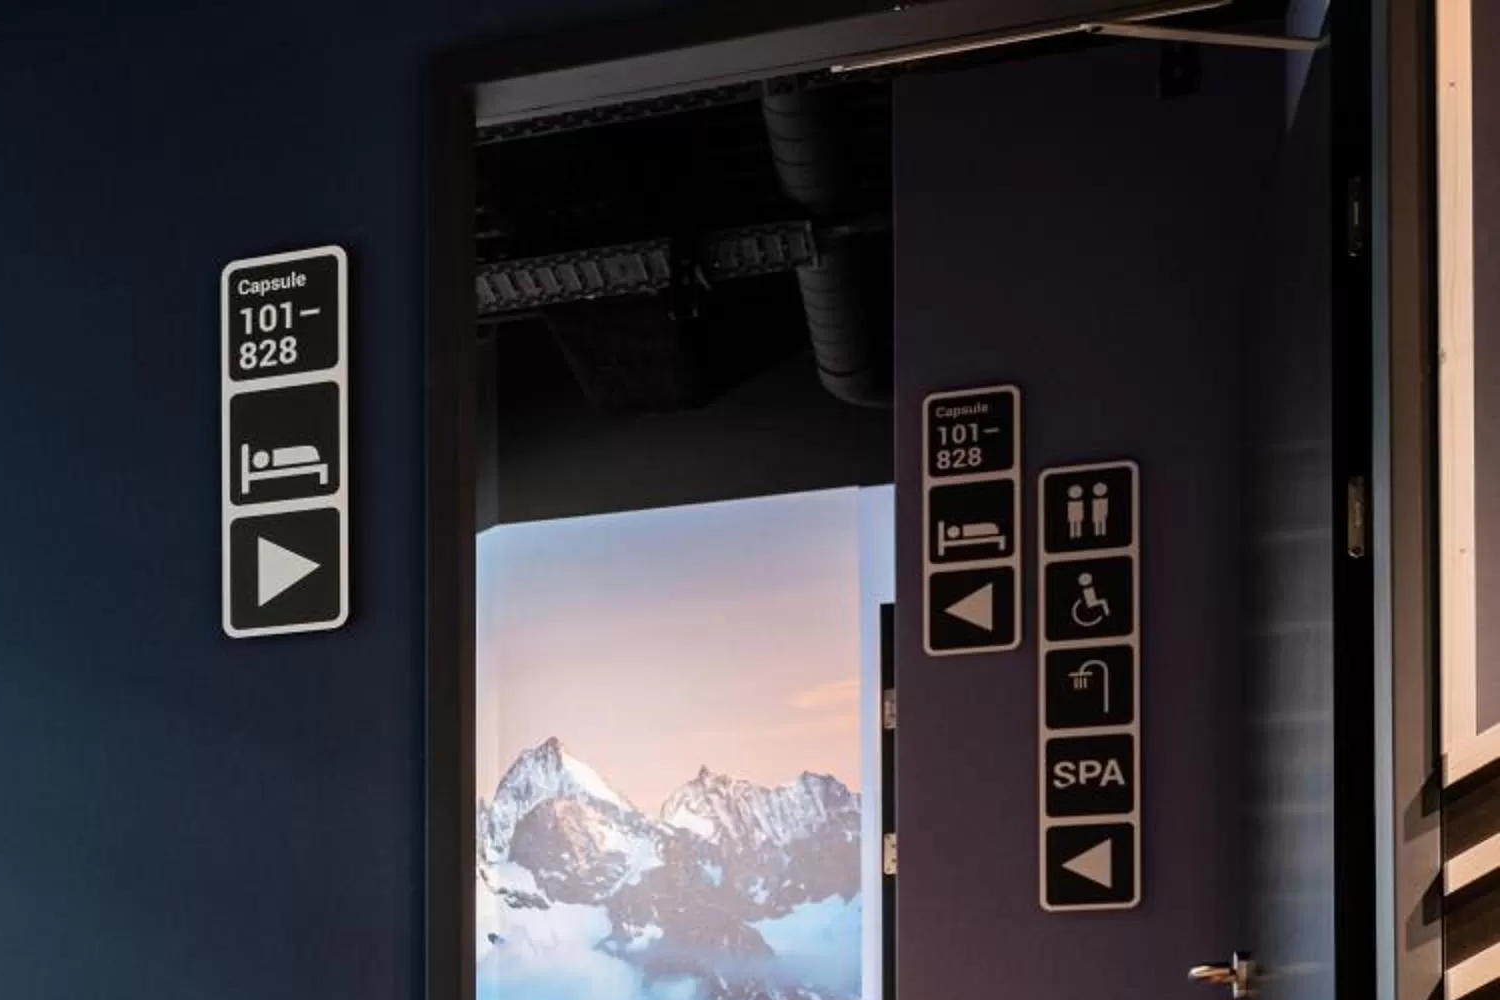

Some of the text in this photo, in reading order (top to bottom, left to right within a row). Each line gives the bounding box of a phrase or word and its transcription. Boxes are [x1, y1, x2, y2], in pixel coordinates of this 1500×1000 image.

[238, 271, 307, 297] Capsule
[239, 335, 297, 370] 828
[935, 402, 989, 419] Capsule
[936, 447, 982, 469] 828
[1053, 758, 1126, 788] SPA
